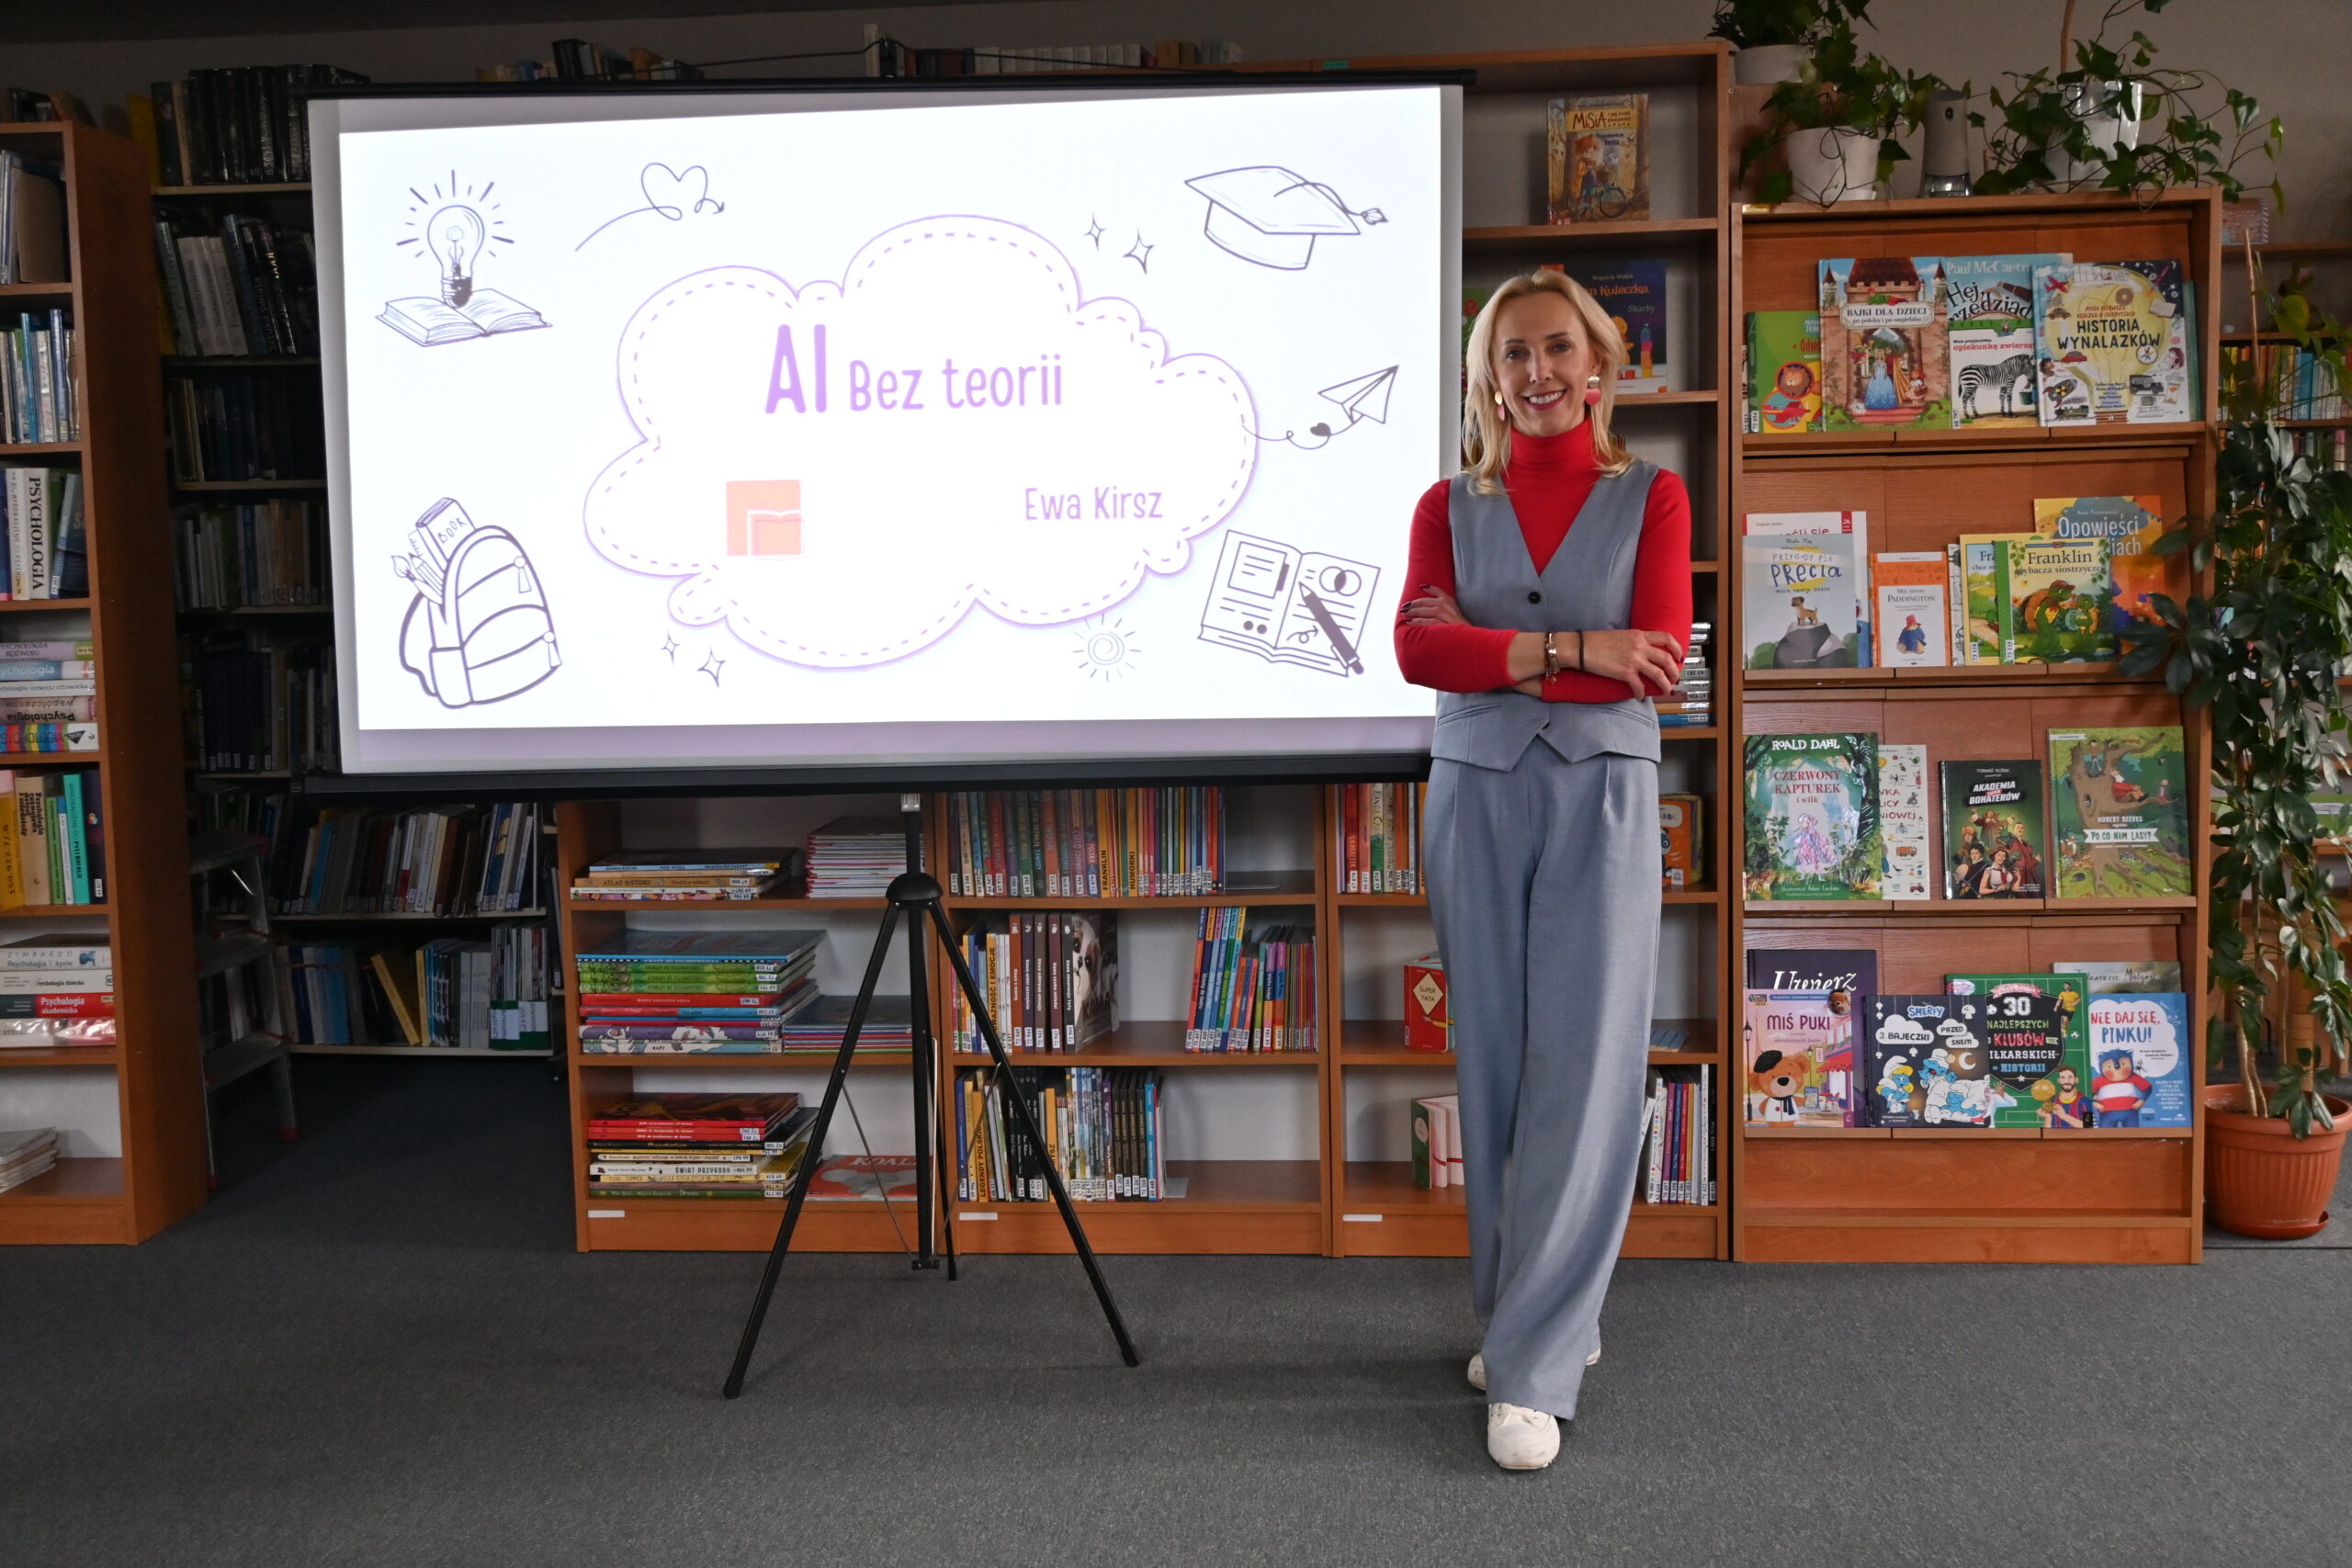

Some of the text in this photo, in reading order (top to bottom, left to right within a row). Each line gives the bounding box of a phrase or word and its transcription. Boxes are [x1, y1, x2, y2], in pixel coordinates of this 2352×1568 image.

[1946, 259, 2032, 275] Paul McCartn
[1600, 284, 1650, 297] Kuleczka
[1946, 281, 1984, 307] Hej,
[1627, 304, 1656, 314] Skarby
[1847, 307, 1928, 318] BAJKI DLA DZIECI
[2076, 318, 2140, 334] HISTORIA
[2057, 329, 2161, 350] WYNALAZKÓW
[1953, 342, 2034, 352] opiekunkę zwierzą
[764, 323, 1062, 414] AI Bez teorii
[1024, 485, 1163, 521] Ewa Kirsz
[437, 517, 468, 544] BOOK
[2057, 514, 2140, 539] Opowieści
[28, 477, 45, 591] PSYCHOLOGIA
[1772, 552, 1814, 563] PRZYGODY
[2028, 549, 2093, 565] Franklin
[1887, 594, 1936, 603] PADDINGTON
[0, 665, 55, 678] ychologia
[7, 711, 76, 722] Psychologia
[1771, 739, 1840, 751] ROALD DAHL
[1773, 770, 1841, 781] CZERWONY
[1774, 784, 1841, 795] KAPTUREK
[1973, 780, 2016, 793] AKADEMIA
[1969, 791, 2020, 806] BOHATERÓW
[2091, 830, 2152, 840] PO CO NAM LASY?
[7, 960, 47, 968] Psychologia
[40, 997, 85, 1007] Psychologia
[2003, 996, 2031, 1017] 30
[1907, 1004, 1945, 1019] SMERFY
[2115, 1011, 2135, 1024] DAJ
[1766, 1012, 1831, 1031] MIŚ PUKI
[1986, 1020, 2050, 1030] NAJLEPSZYCH
[1940, 1025, 1964, 1033] PRZED
[2101, 1026, 2153, 1044] PINKU!
[1879, 1032, 1930, 1042] 3 BAJECZKI
[1993, 1030, 2045, 1047] KLUBÓW
[1989, 1050, 2056, 1060] IŁKARSKICH
[2000, 1063, 2046, 1073] HISTORII
[848, 1157, 916, 1166] KOAL
[978, 1167, 987, 1198] LEGENDY
